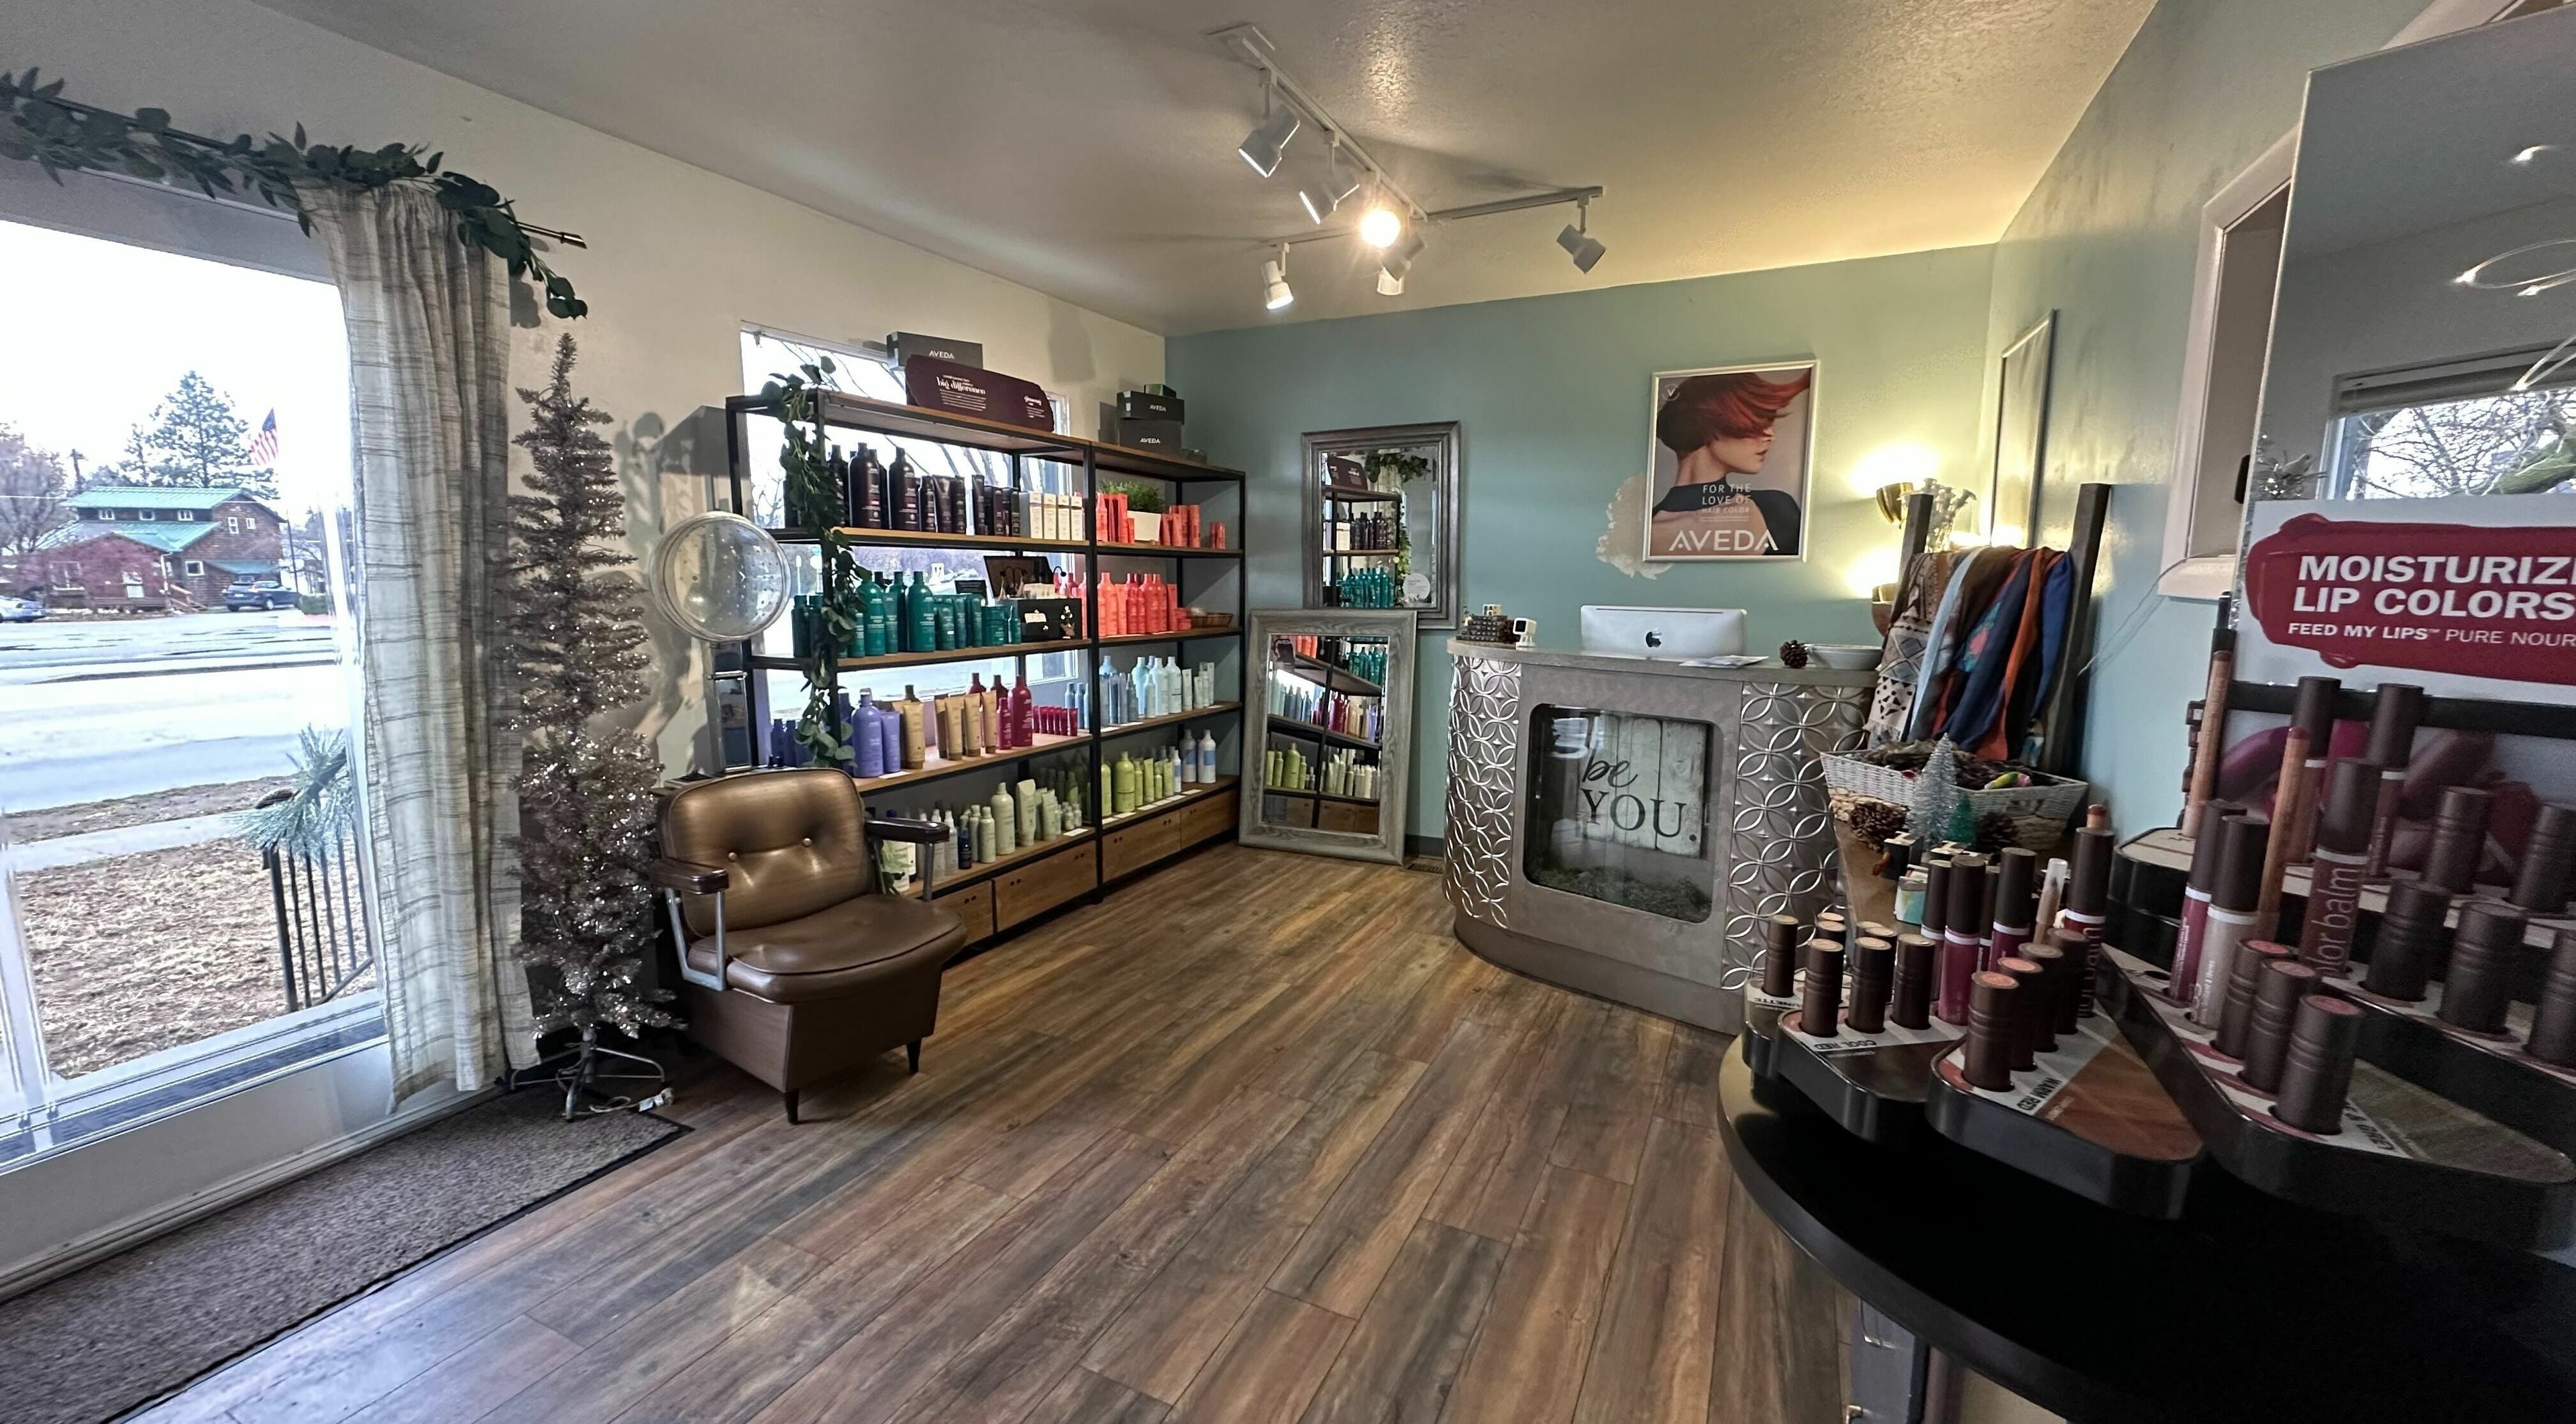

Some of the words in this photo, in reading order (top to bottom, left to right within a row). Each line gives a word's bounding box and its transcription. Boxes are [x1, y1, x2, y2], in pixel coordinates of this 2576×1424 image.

[929, 350, 955, 360] AVEDA
[936, 376, 950, 390] big
[1703, 484, 1725, 494] FOR
[1729, 483, 1752, 493] THE
[1702, 496, 1731, 505] LOVE
[1735, 495, 1752, 504] OF
[1701, 506, 1722, 514] HAIR
[1669, 529, 1778, 551] AVEDA
[2293, 588, 2360, 613] LIP
[2374, 590, 2576, 620] COLORS
[2288, 622, 2337, 636] FEED
[2344, 625, 2375, 638] MY
[2445, 629, 2504, 644] PURE
[1582, 741, 1638, 787] be
[1580, 788, 1697, 842] YOU.
[2311, 867, 2361, 930] balm
[1814, 1042, 1841, 1050] RED
[1843, 1039, 1877, 1048] COOL
[2030, 1077, 2062, 1099] WARM
[2016, 1095, 2042, 1111] RED
